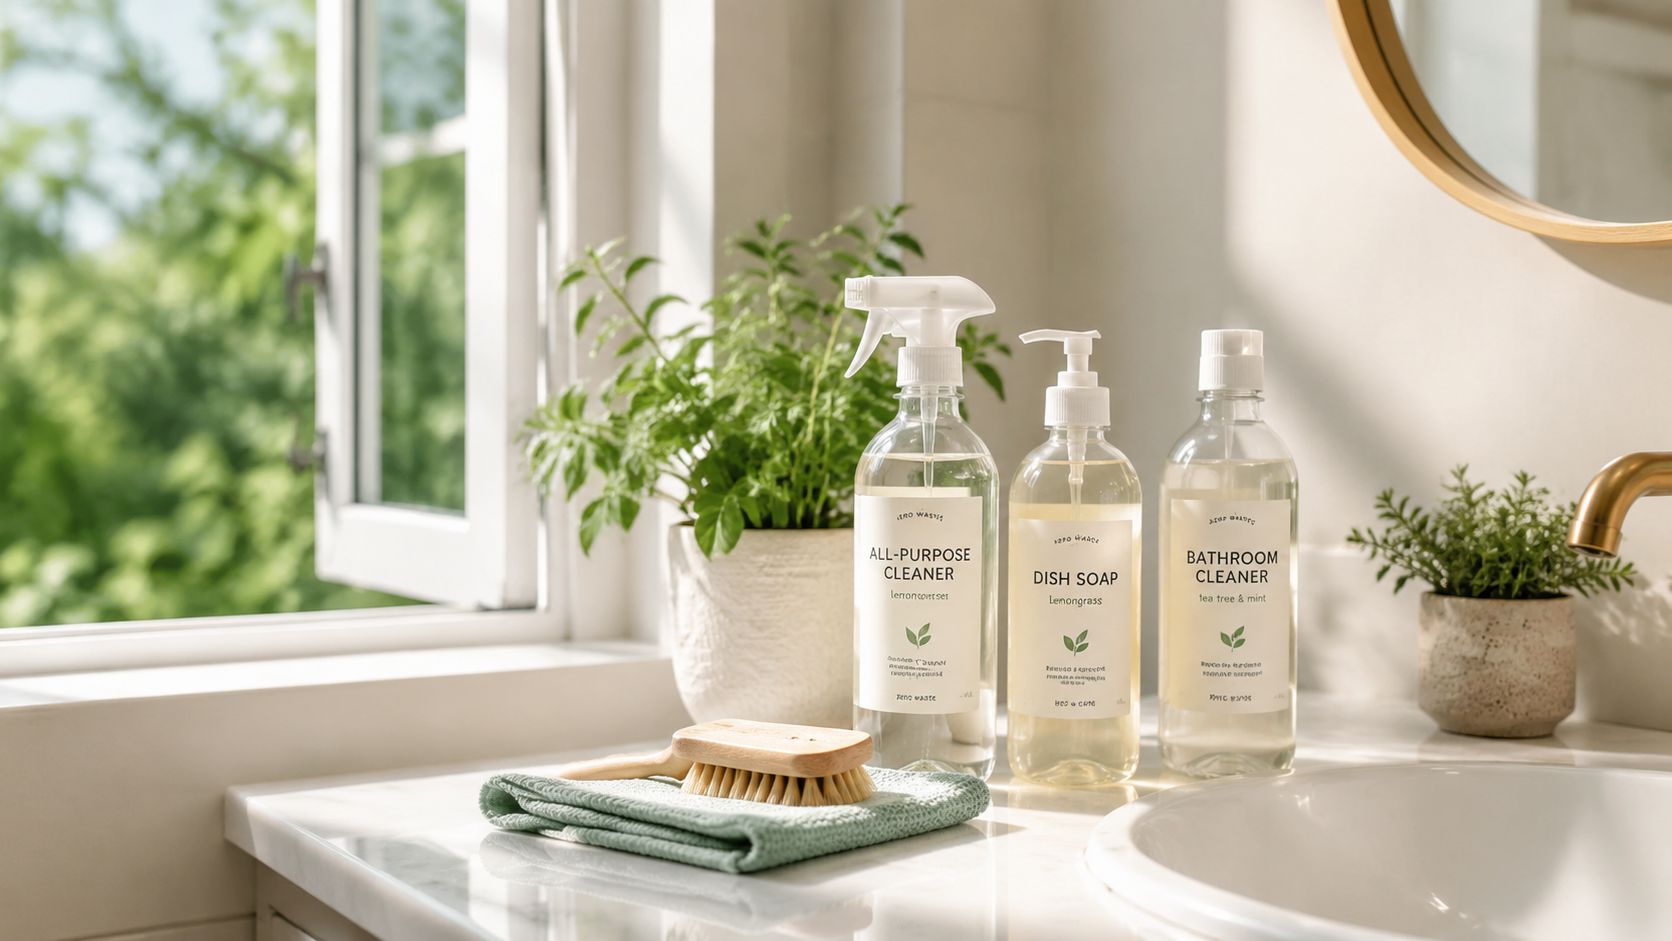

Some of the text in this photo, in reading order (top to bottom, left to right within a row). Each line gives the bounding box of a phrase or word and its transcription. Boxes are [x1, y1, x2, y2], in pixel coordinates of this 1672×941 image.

[869, 546, 971, 562] ALL-PURPOSE
[1186, 550, 1278, 565] BATHROOM
[883, 565, 954, 581] CLEANER
[1033, 570, 1119, 586] DISH SOAP
[1195, 569, 1269, 584] CLEANER
[1199, 592, 1267, 604] tea tree & mint
